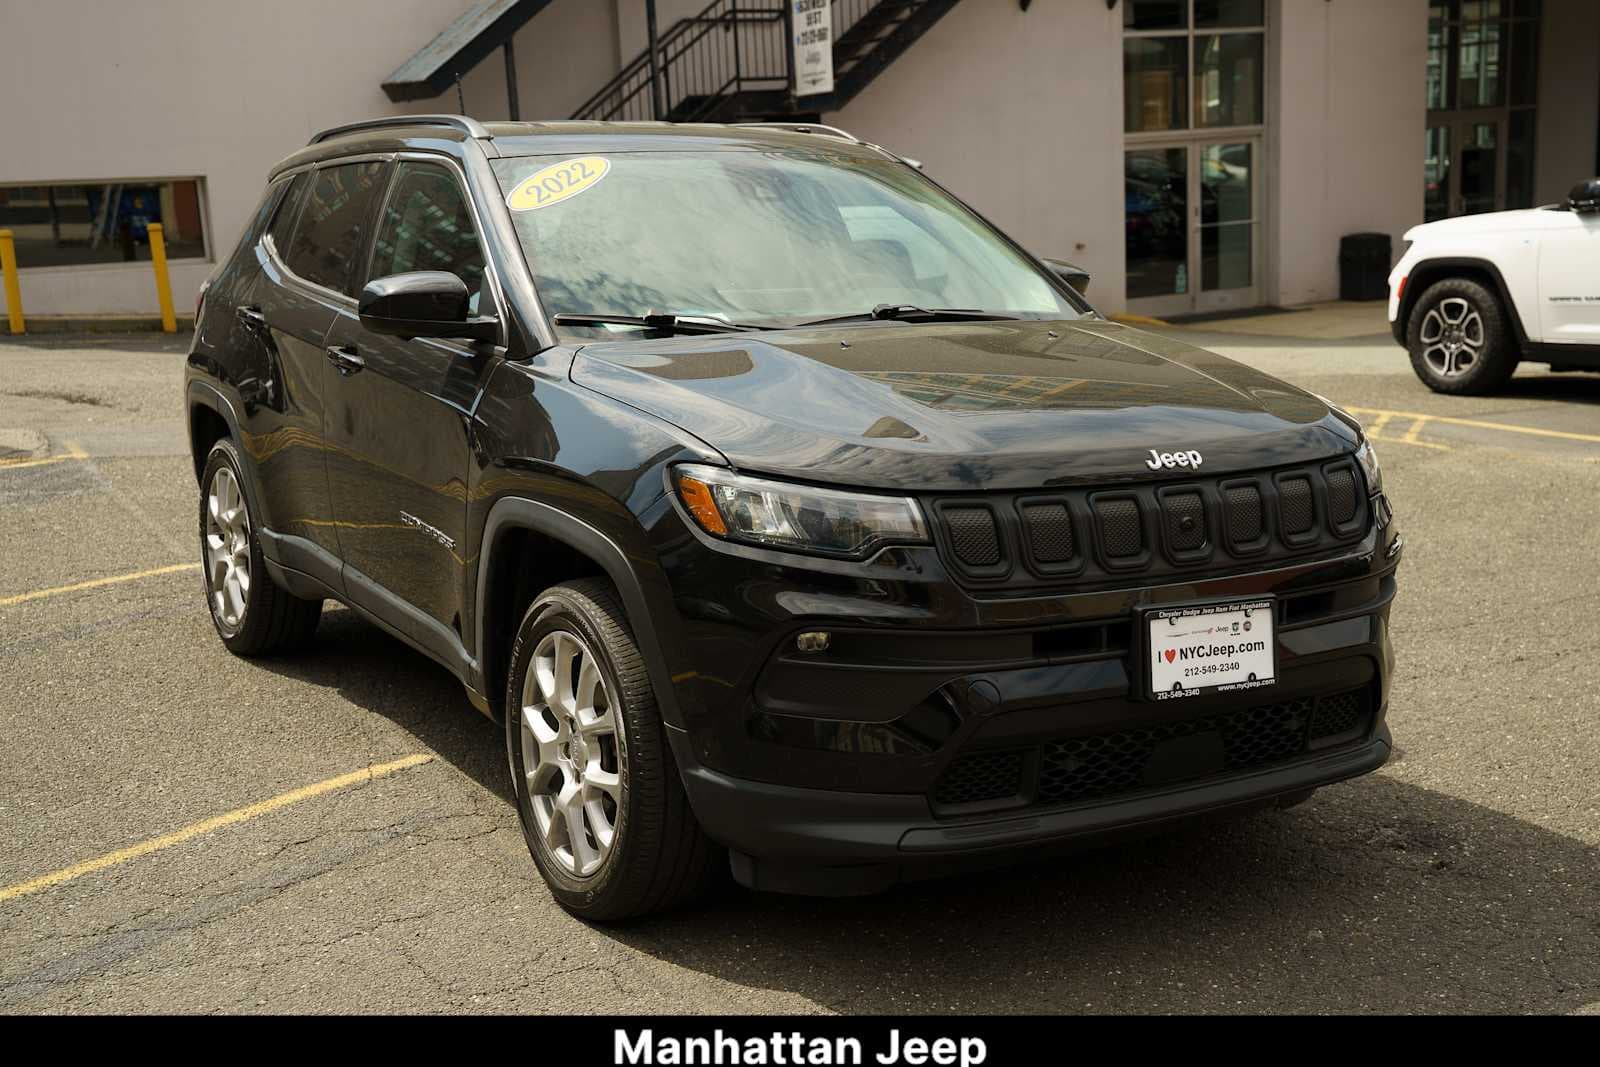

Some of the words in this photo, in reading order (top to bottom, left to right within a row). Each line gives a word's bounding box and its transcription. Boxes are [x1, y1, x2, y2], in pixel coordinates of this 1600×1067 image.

[525, 162, 595, 203] 2022
[1145, 449, 1203, 470] Jeep
[1158, 609, 1182, 618] Chrysler
[1183, 608, 1201, 617] Dodge
[1202, 607, 1215, 615] Jeep
[1240, 602, 1270, 611] Manhattan
[1179, 640, 1266, 661] NYCJeep.com
[1184, 662, 1240, 677] 212-549-2340
[1217, 678, 1275, 691] www.nycjeep.com
[1157, 688, 1200, 700] 212-549-2340
